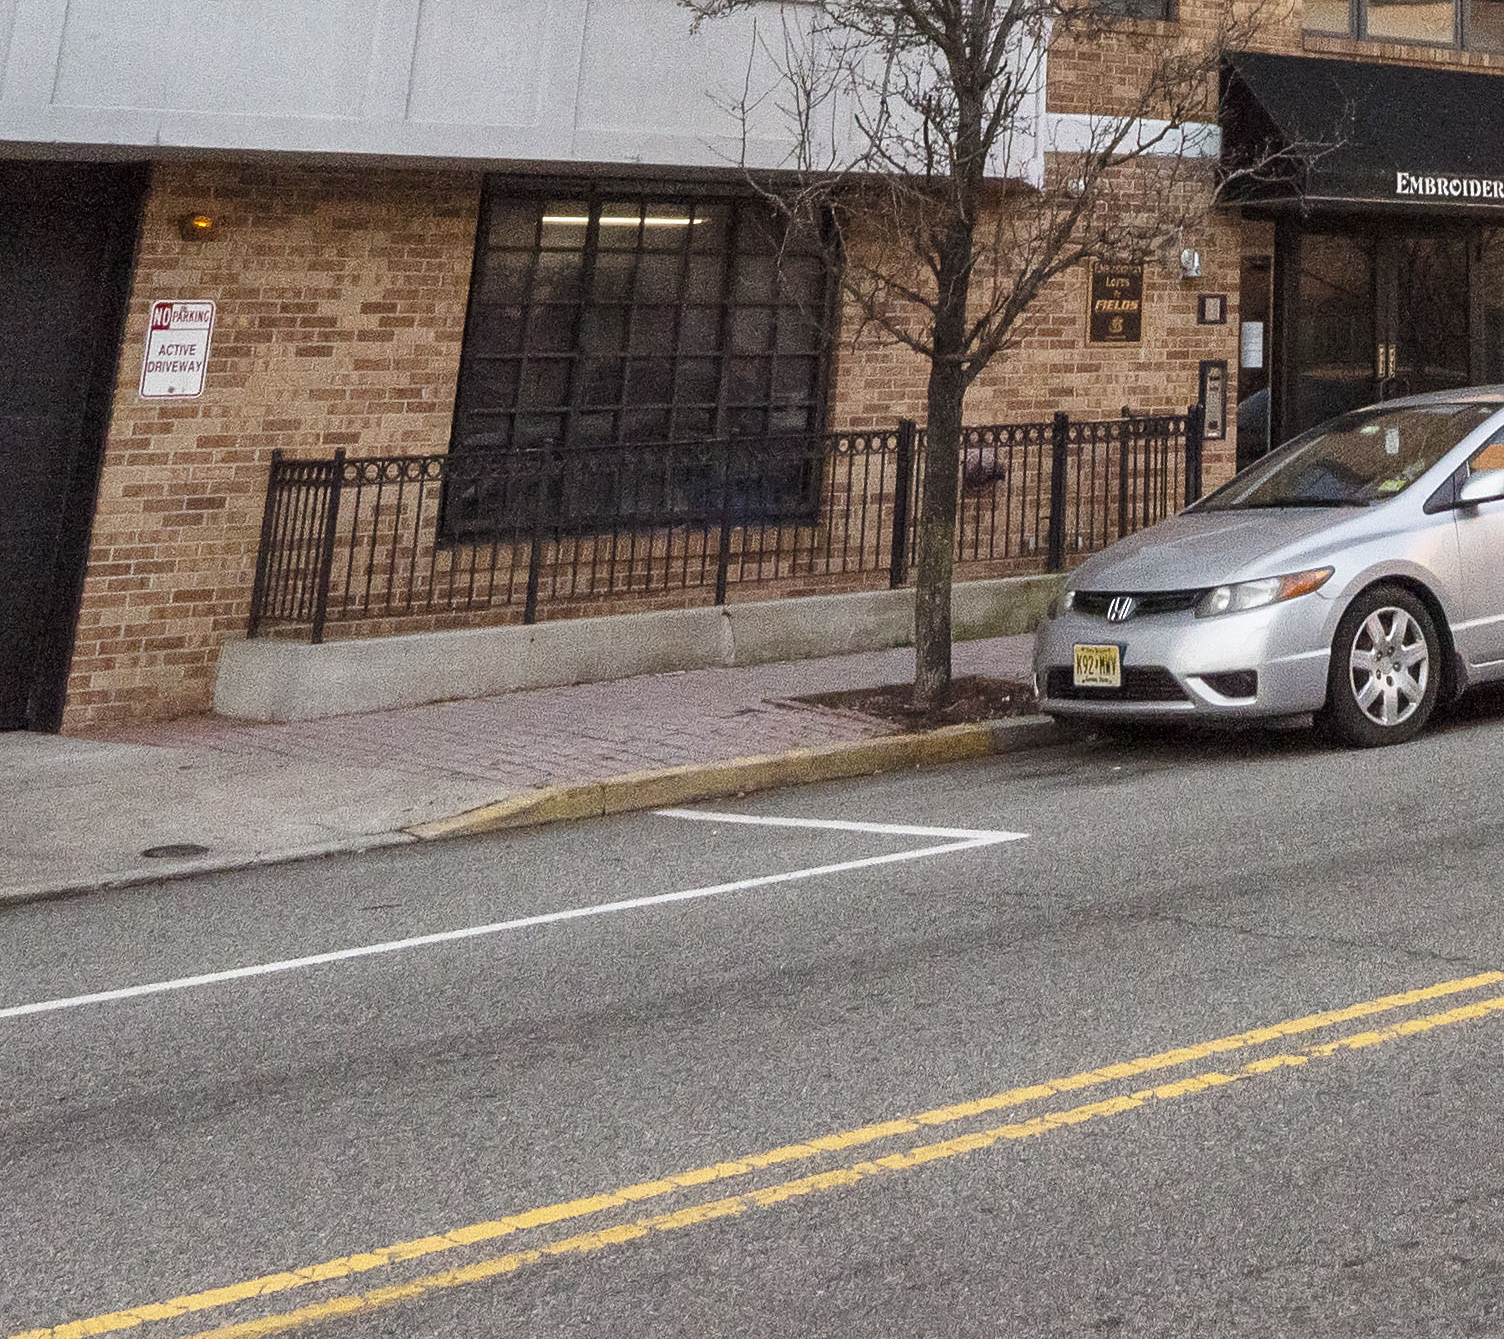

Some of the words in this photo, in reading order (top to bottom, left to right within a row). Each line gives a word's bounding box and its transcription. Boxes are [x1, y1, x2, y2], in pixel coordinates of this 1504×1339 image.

[1095, 299, 1140, 312] FIELDS
[153, 307, 172, 326] NO
[172, 310, 210, 322] PARKING
[158, 344, 197, 356] ACTIVE
[147, 360, 202, 373] DRIVEWAY
